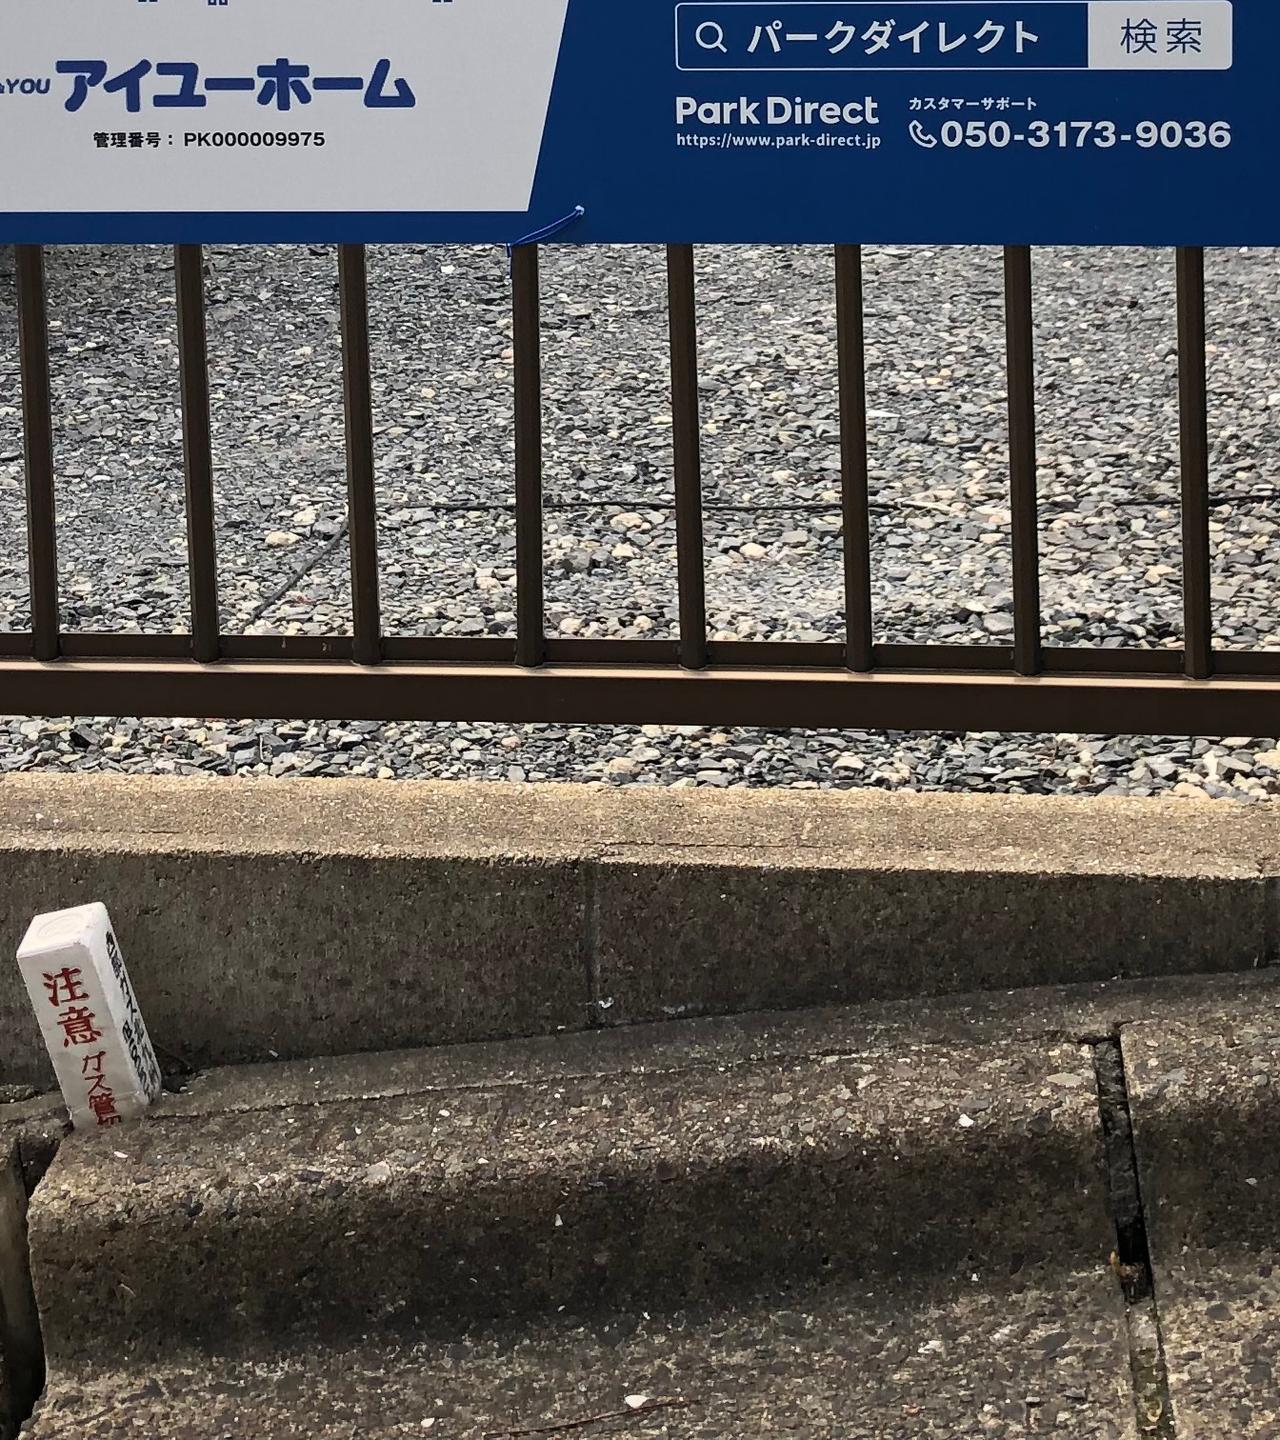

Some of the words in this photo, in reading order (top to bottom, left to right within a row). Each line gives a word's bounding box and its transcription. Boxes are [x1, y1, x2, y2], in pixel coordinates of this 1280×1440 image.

[746, 18, 1039, 55] パークダイレクト
[1120, 17, 1202, 54] 検索
[55, 57, 416, 113] アイユーホーム
[675, 96, 761, 125] Park
[766, 96, 880, 125] Direct
[909, 96, 1037, 111] カスタマーサポート
[676, 132, 881, 150] https://www.park-direct.jp
[940, 120, 1232, 148] 050-3173-9036
